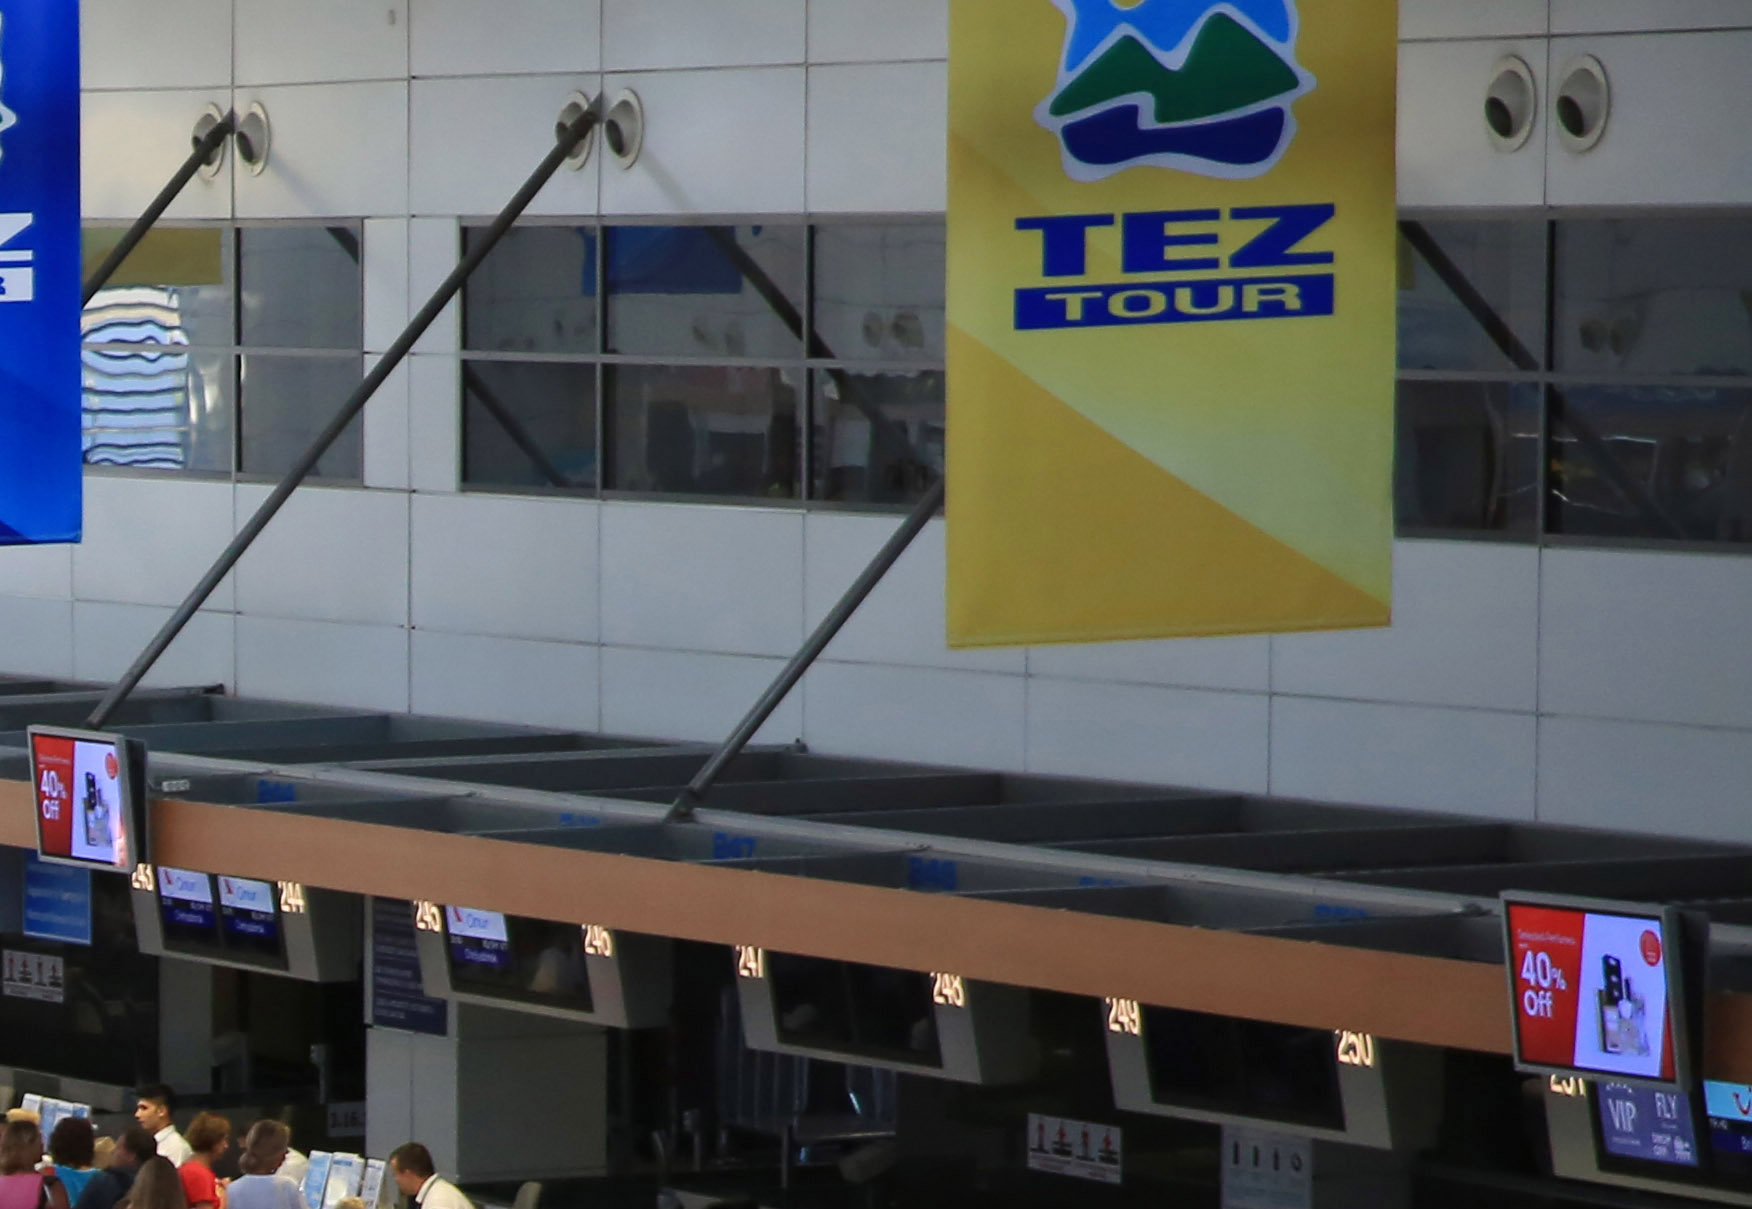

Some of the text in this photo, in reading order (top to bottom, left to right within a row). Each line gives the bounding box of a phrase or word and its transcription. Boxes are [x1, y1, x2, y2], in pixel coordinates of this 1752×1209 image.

[1014, 203, 1335, 277] TEZ
[1045, 281, 1302, 321] TOUR
[41, 769, 67, 799] 40%
[277, 880, 305, 913] 244
[413, 900, 441, 933] 245
[736, 945, 764, 979] 247
[1521, 950, 1567, 990] 40%
[930, 971, 964, 1008] 248
[1524, 989, 1553, 1019] Off
[1106, 997, 1142, 1036] 249
[1334, 1029, 1374, 1067] 250
[1608, 1098, 1637, 1132] VIP
[1654, 1092, 1677, 1119] FLY
